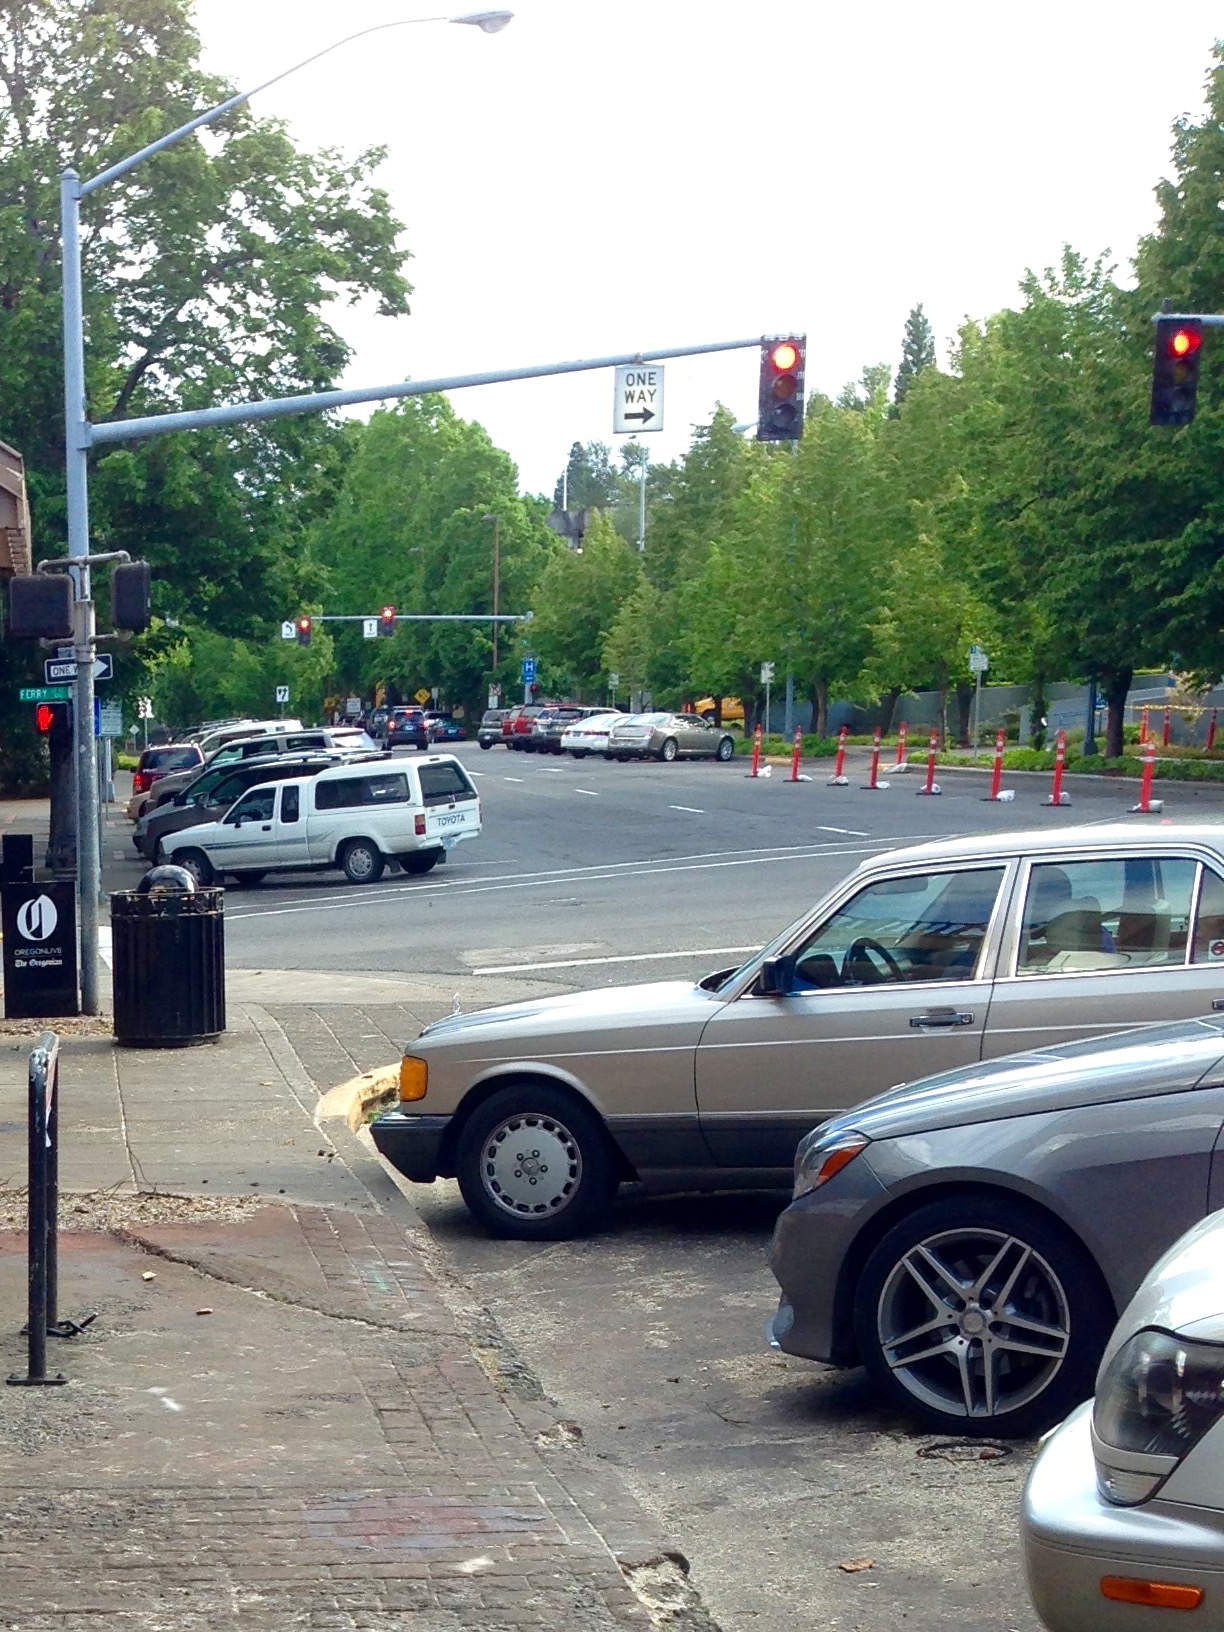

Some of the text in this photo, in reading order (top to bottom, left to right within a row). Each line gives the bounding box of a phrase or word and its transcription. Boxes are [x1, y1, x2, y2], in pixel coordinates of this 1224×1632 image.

[625, 371, 657, 387] ONE
[624, 388, 657, 404] WAY
[52, 666, 71, 676] ONE
[19, 688, 48, 700] FERRY
[437, 813, 466, 827] TOYOTA
[13, 946, 63, 956] OREGONLIVE
